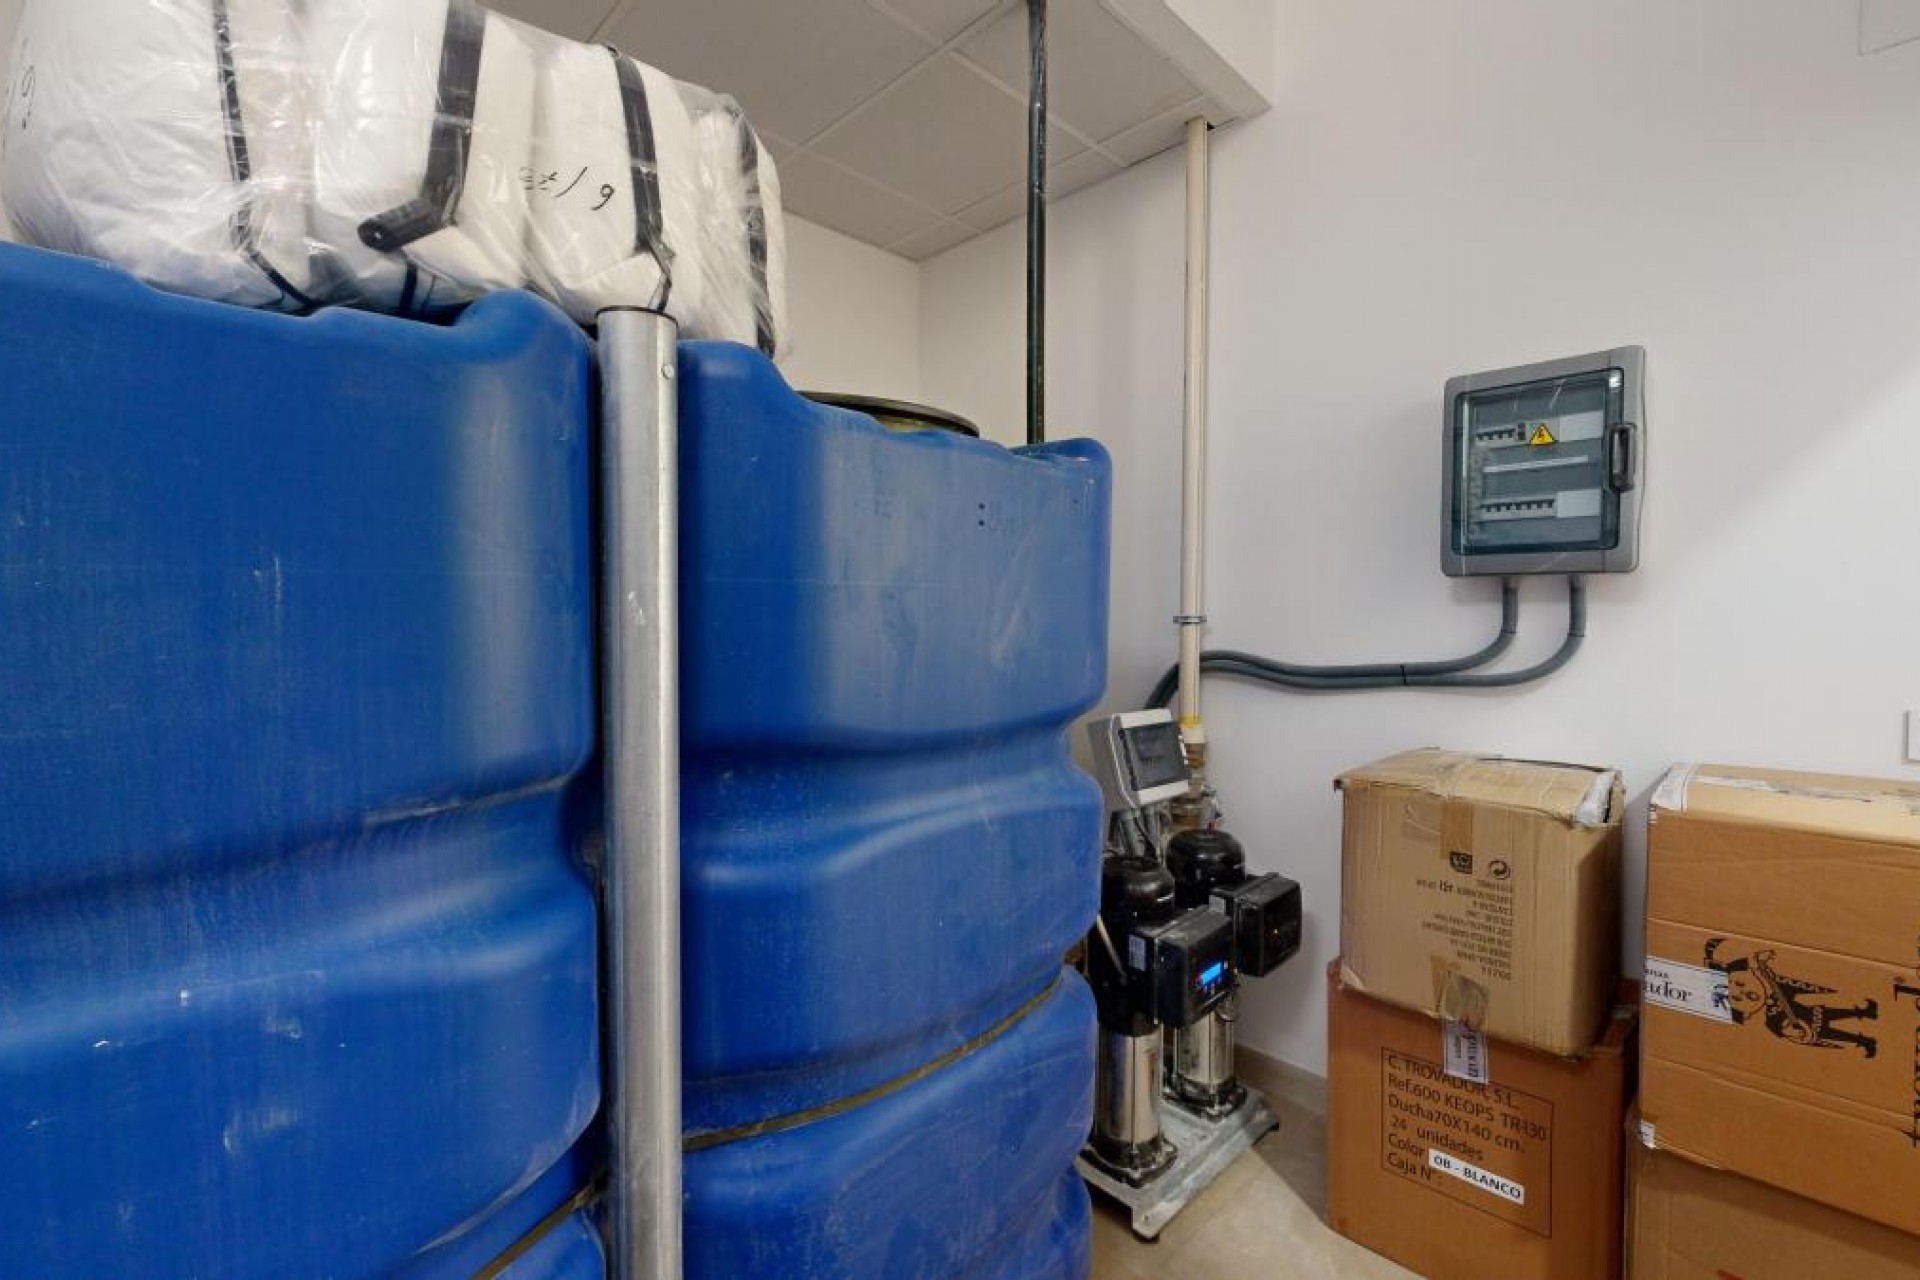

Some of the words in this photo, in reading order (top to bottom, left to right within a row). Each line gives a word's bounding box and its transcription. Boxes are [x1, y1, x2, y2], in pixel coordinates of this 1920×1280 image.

[1445, 1092, 1494, 1122] KEOPS
[1416, 1127, 1484, 1162] unidades
[1386, 1152, 1417, 1176] Caja
[1388, 1133, 1425, 1158] Color
[1463, 1167, 1522, 1199] BLANCO
